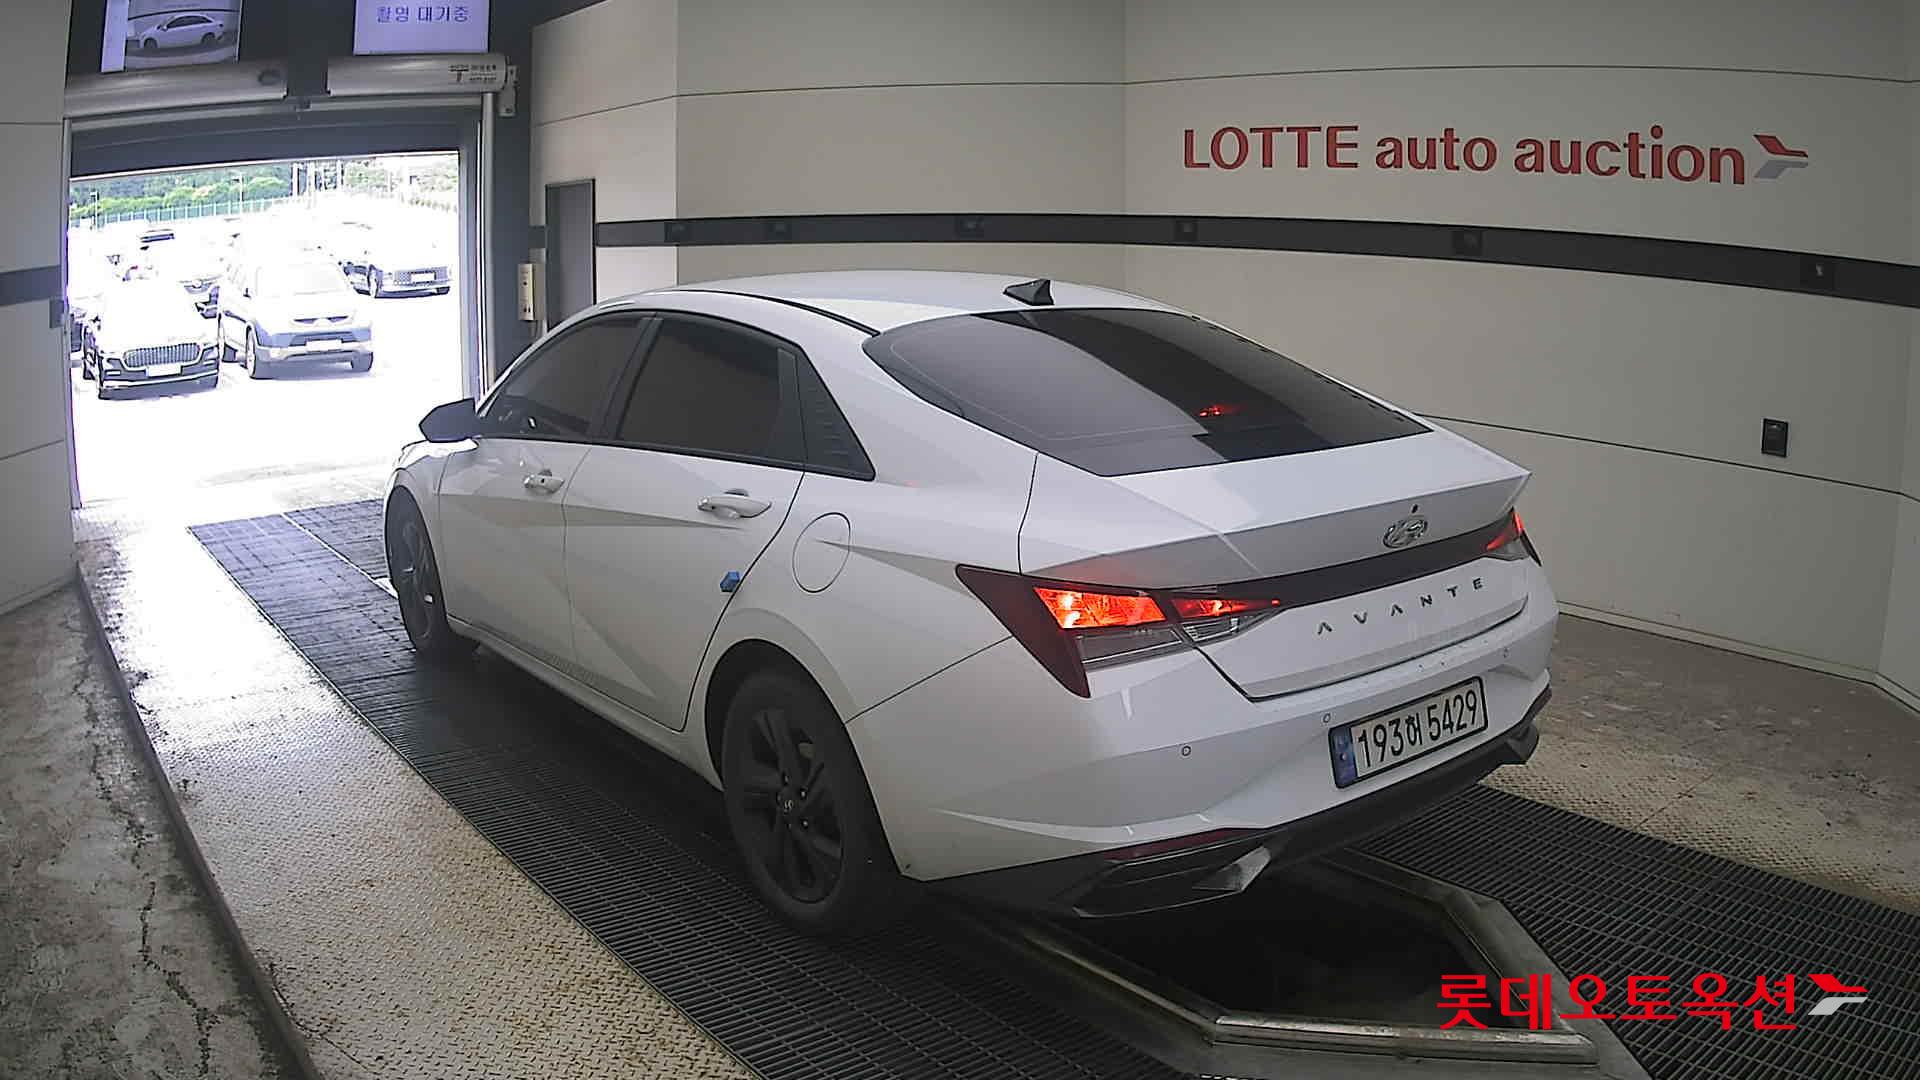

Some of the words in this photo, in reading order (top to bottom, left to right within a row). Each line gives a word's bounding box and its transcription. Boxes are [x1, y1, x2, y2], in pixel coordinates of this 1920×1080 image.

[417, 6, 468, 22] 대기중
[1184, 126, 1359, 170] LOTTE
[1375, 129, 1497, 171] auto
[1514, 125, 1745, 185] auction
[1317, 577, 1484, 635] AVANTE
[1358, 712, 1423, 768] 193허
[1427, 689, 1477, 742] 5429
